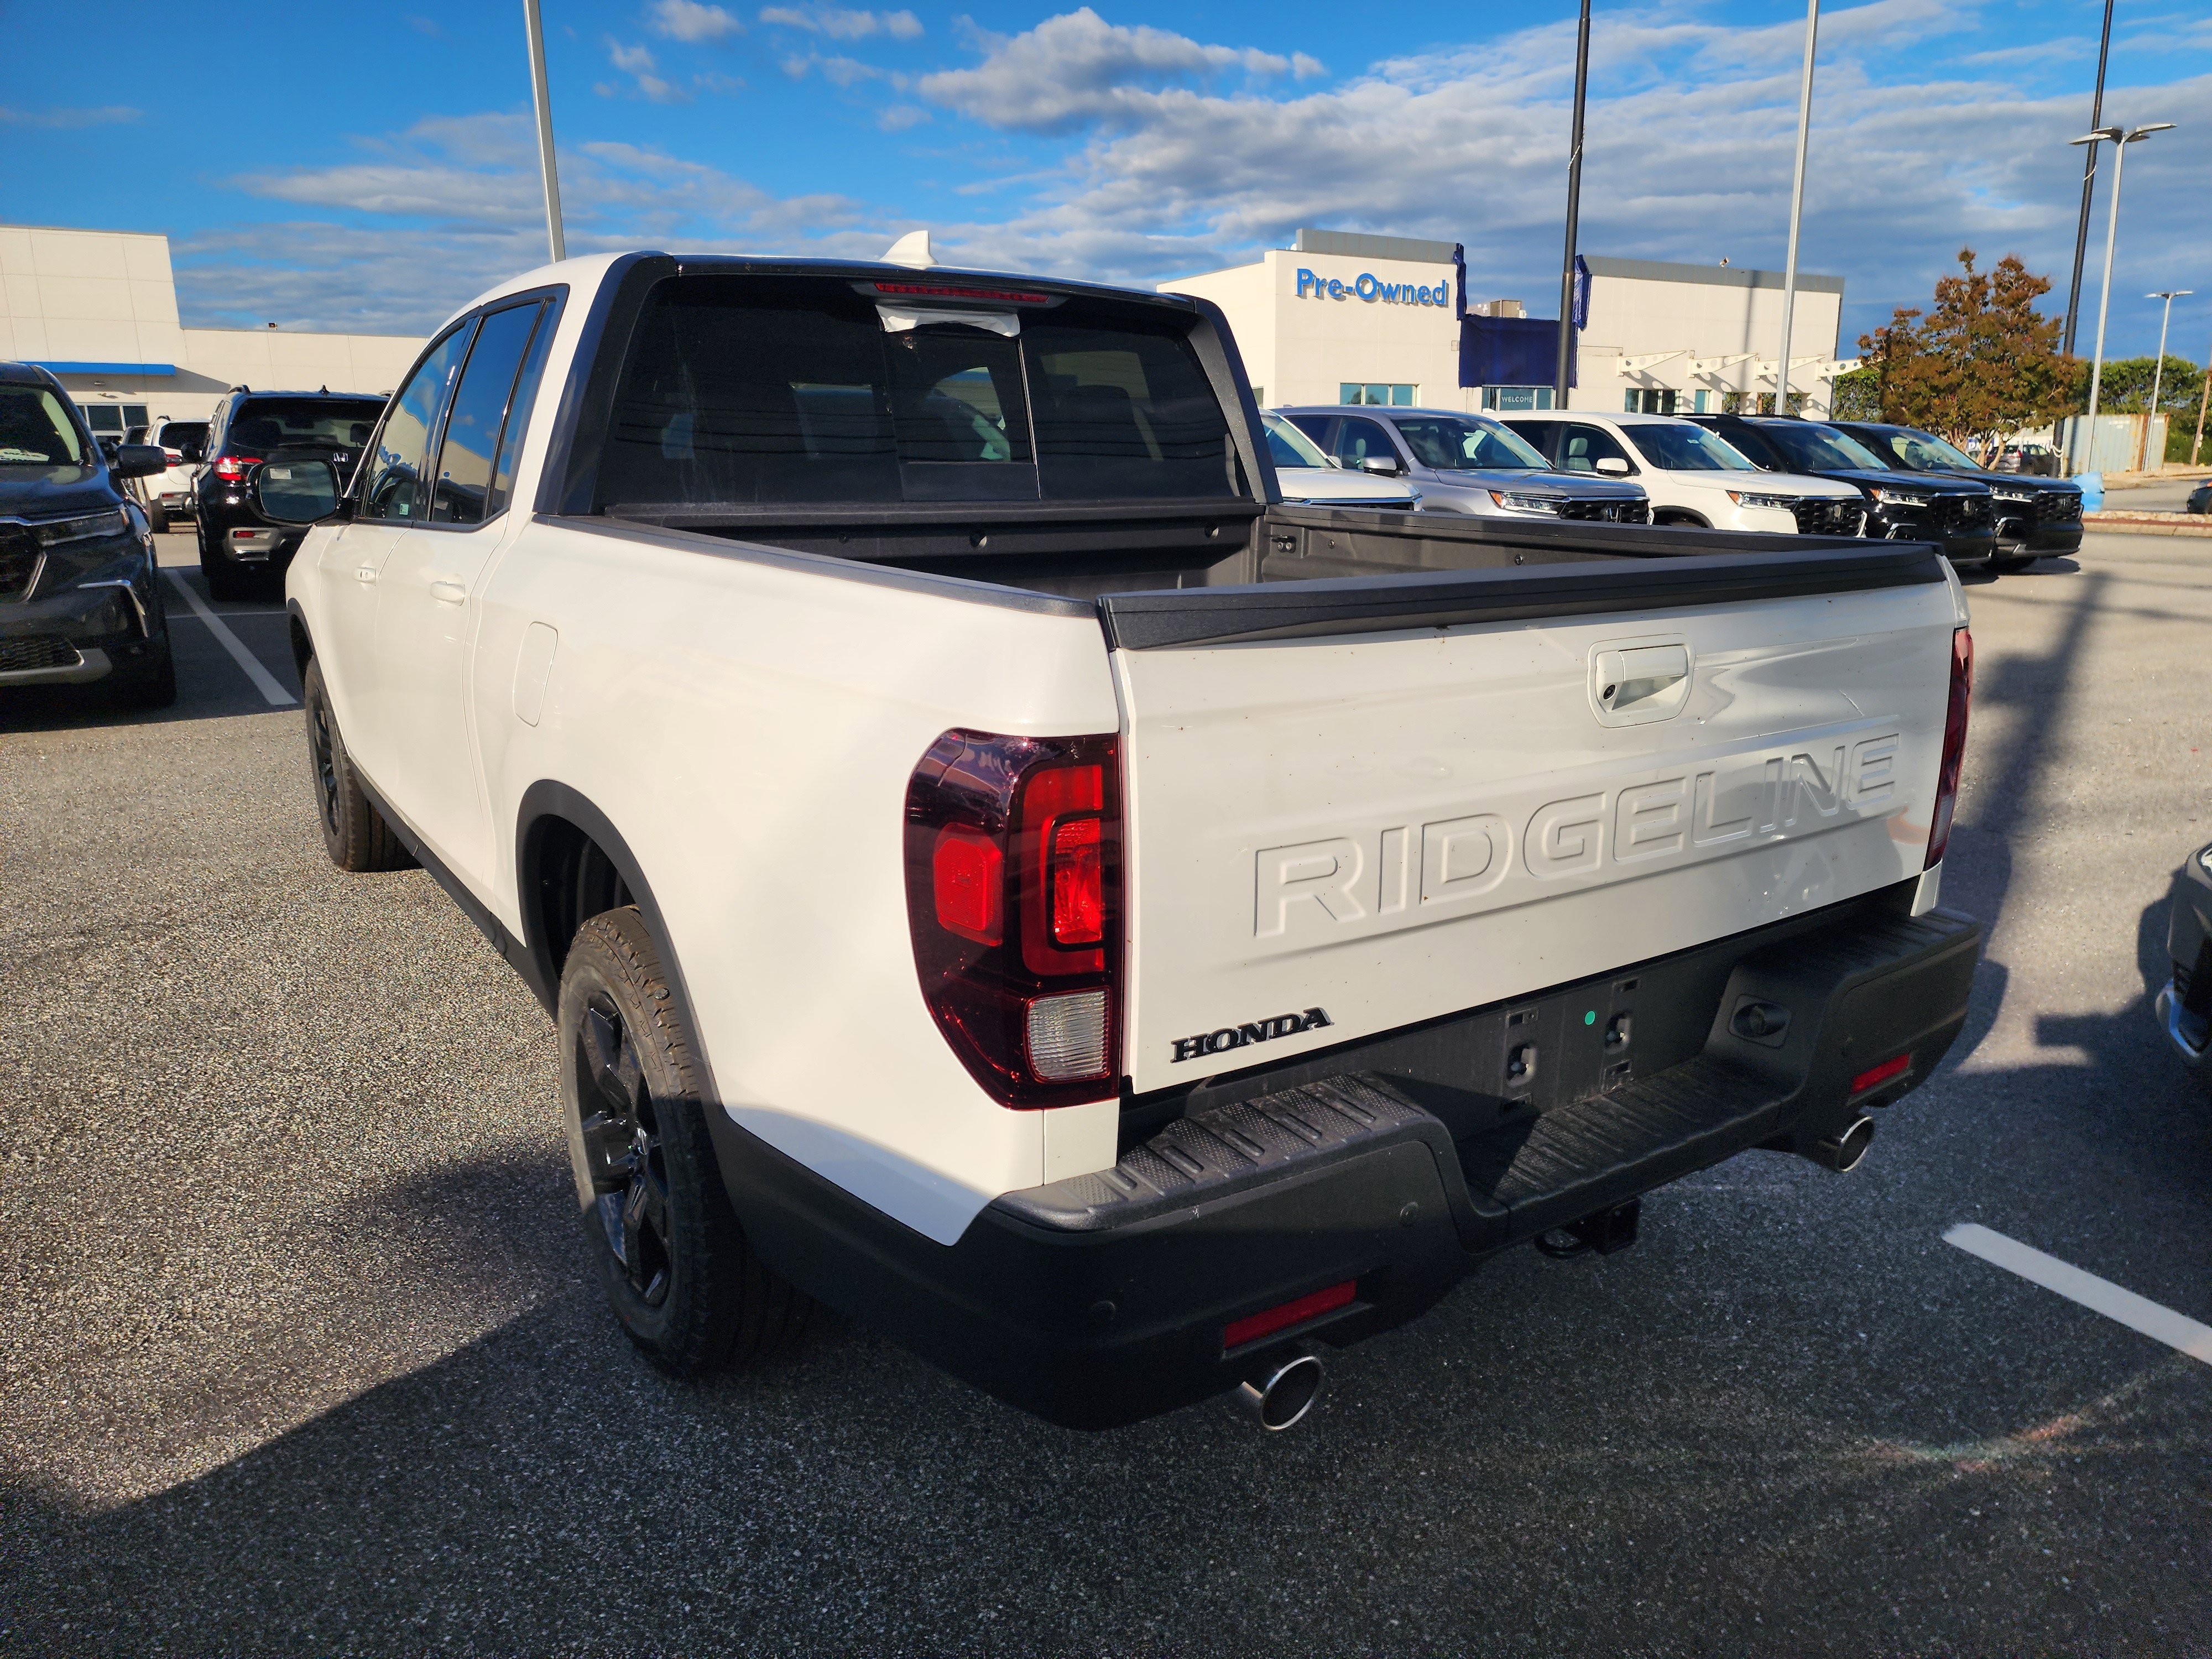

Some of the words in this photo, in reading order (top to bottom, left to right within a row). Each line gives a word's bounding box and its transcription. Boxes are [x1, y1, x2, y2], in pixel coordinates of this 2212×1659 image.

[1296, 268, 1447, 305] Pre-Owned
[1254, 733, 1900, 937] RIDGELINE
[1170, 1006, 1333, 1063] HONDA
